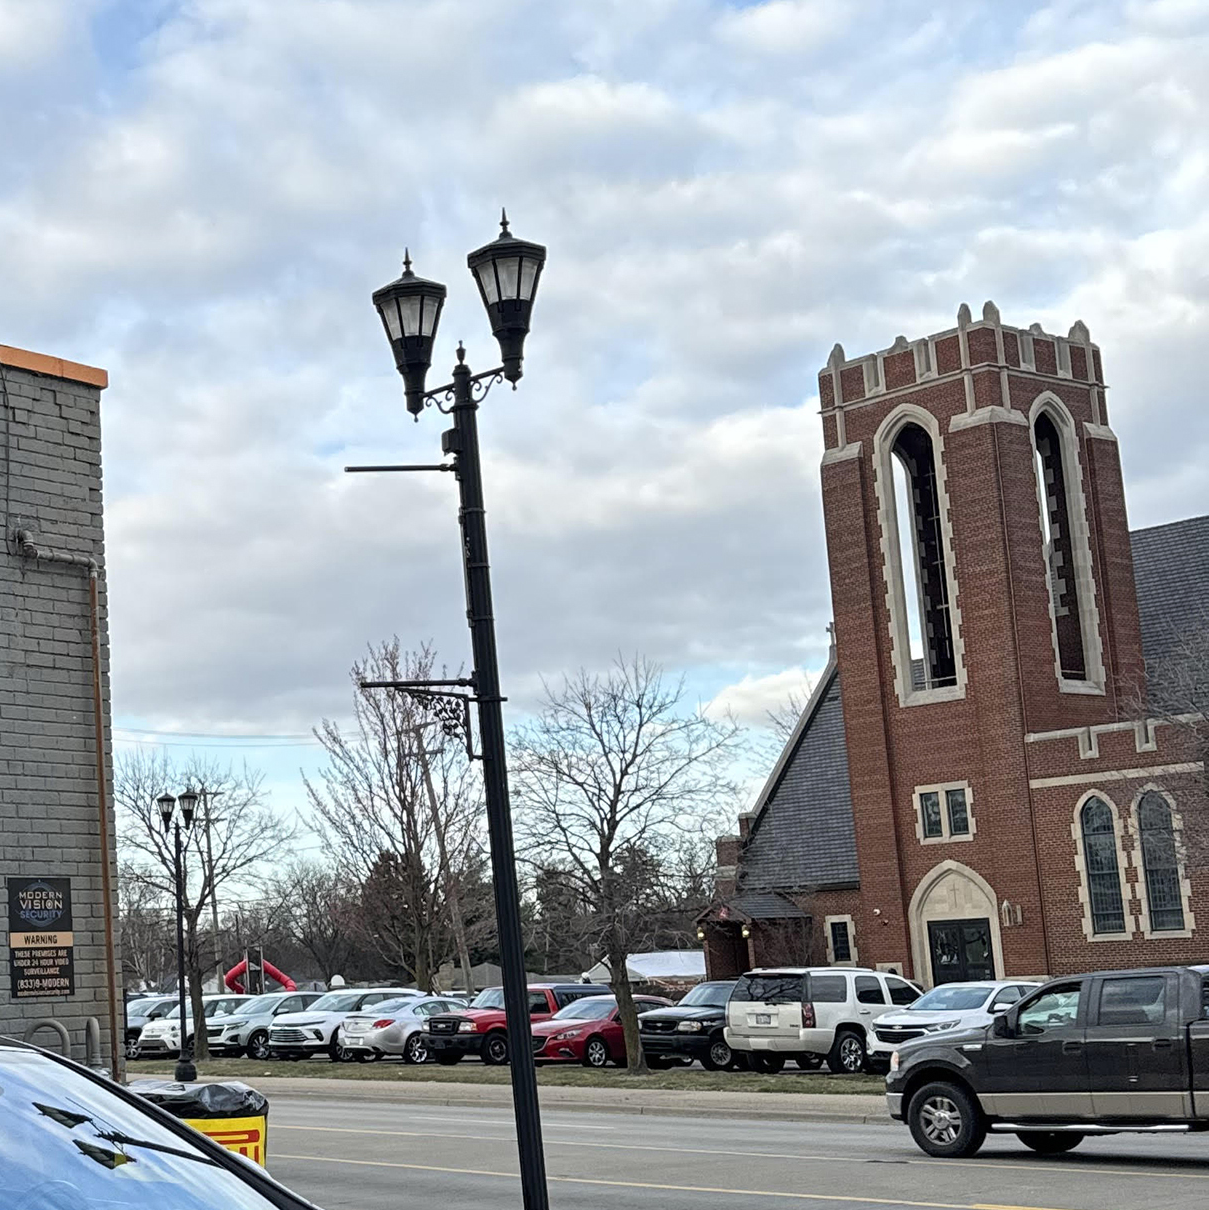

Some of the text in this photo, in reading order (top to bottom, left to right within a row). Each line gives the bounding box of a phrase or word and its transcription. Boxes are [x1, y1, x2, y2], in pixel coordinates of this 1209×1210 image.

[19, 891, 63, 899] MODERN
[19, 899, 63, 910] VISION
[20, 910, 62, 919] SECURITY
[24, 935, 58, 945] WARNING
